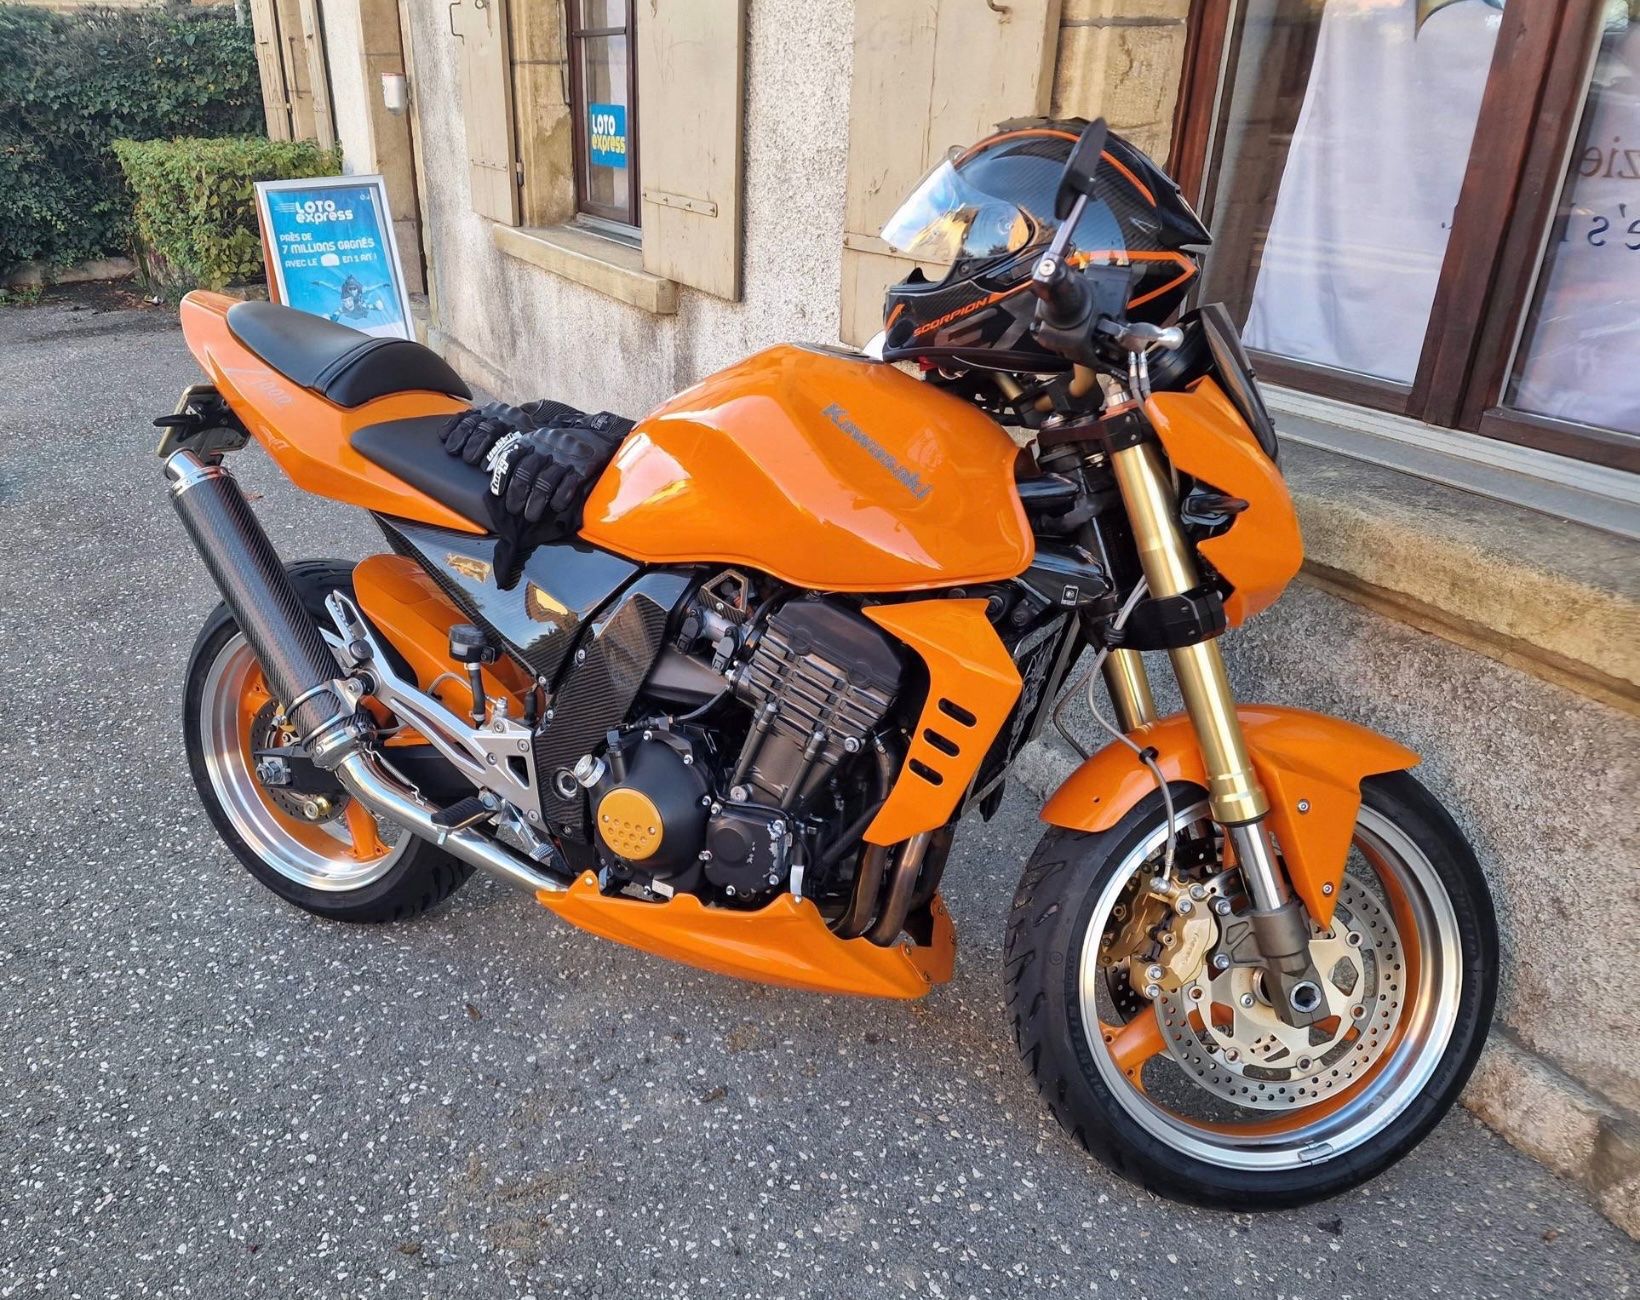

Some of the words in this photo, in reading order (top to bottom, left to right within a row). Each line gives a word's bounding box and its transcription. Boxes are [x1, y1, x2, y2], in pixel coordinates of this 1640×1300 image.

[592, 114, 616, 136] LOTO
[592, 134, 626, 155] express
[296, 200, 335, 214] LOTO
[296, 209, 354, 224] express
[301, 232, 313, 241] DE
[282, 245, 289, 254] 7
[291, 241, 336, 255] MILLIONS
[337, 237, 375, 250] GAGNÉS
[285, 259, 307, 268] AVEC
[307, 258, 318, 266] LE
[913, 297, 989, 337] SCORPION
[821, 402, 933, 500] Kawasaki
